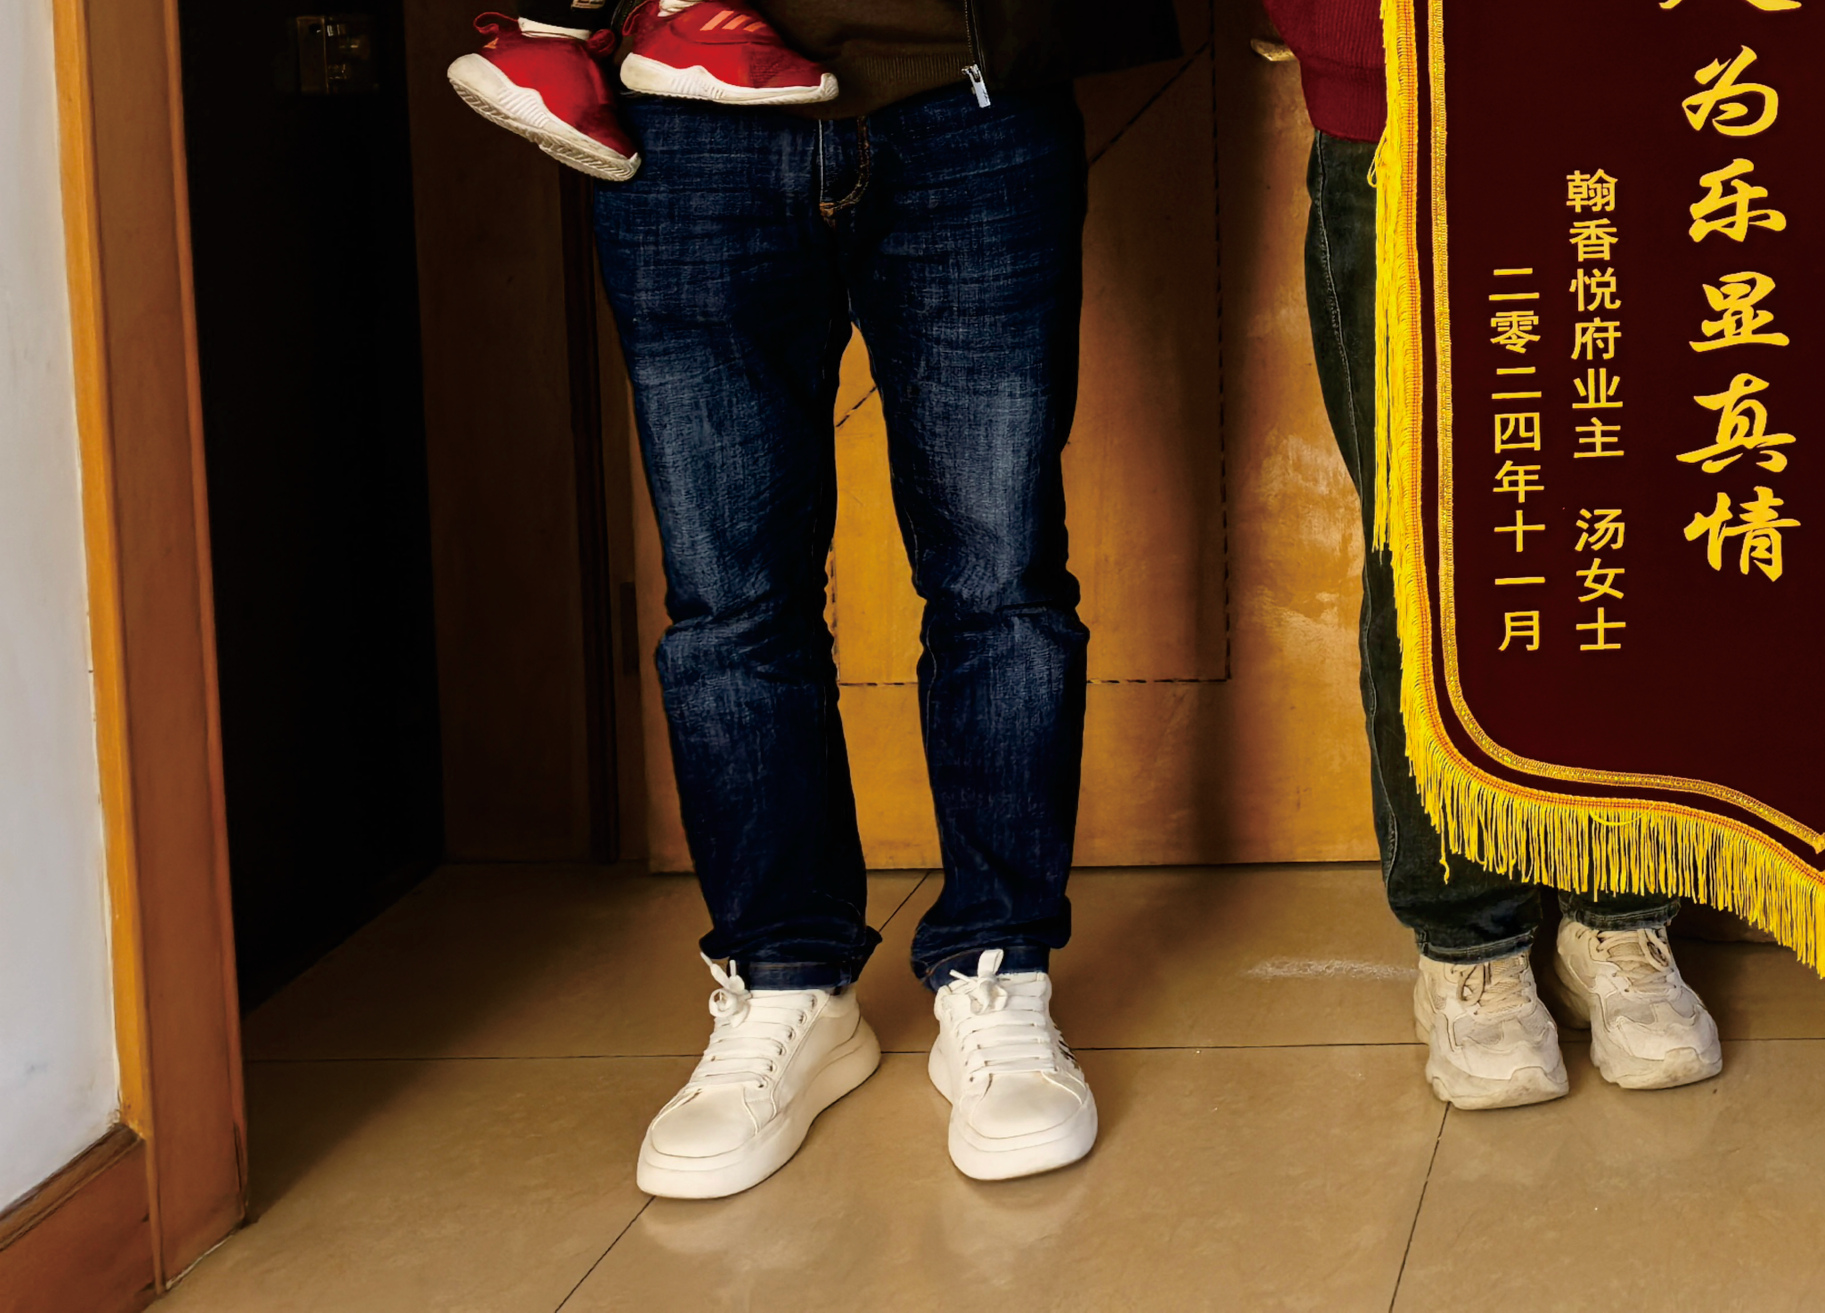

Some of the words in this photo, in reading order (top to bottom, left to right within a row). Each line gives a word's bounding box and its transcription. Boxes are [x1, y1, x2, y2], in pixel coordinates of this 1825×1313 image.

[1488, 266, 1547, 654] 二零二四年十一月
[1566, 168, 1626, 461] 翰香悦府业主
[1574, 508, 1628, 653] 汤女士
